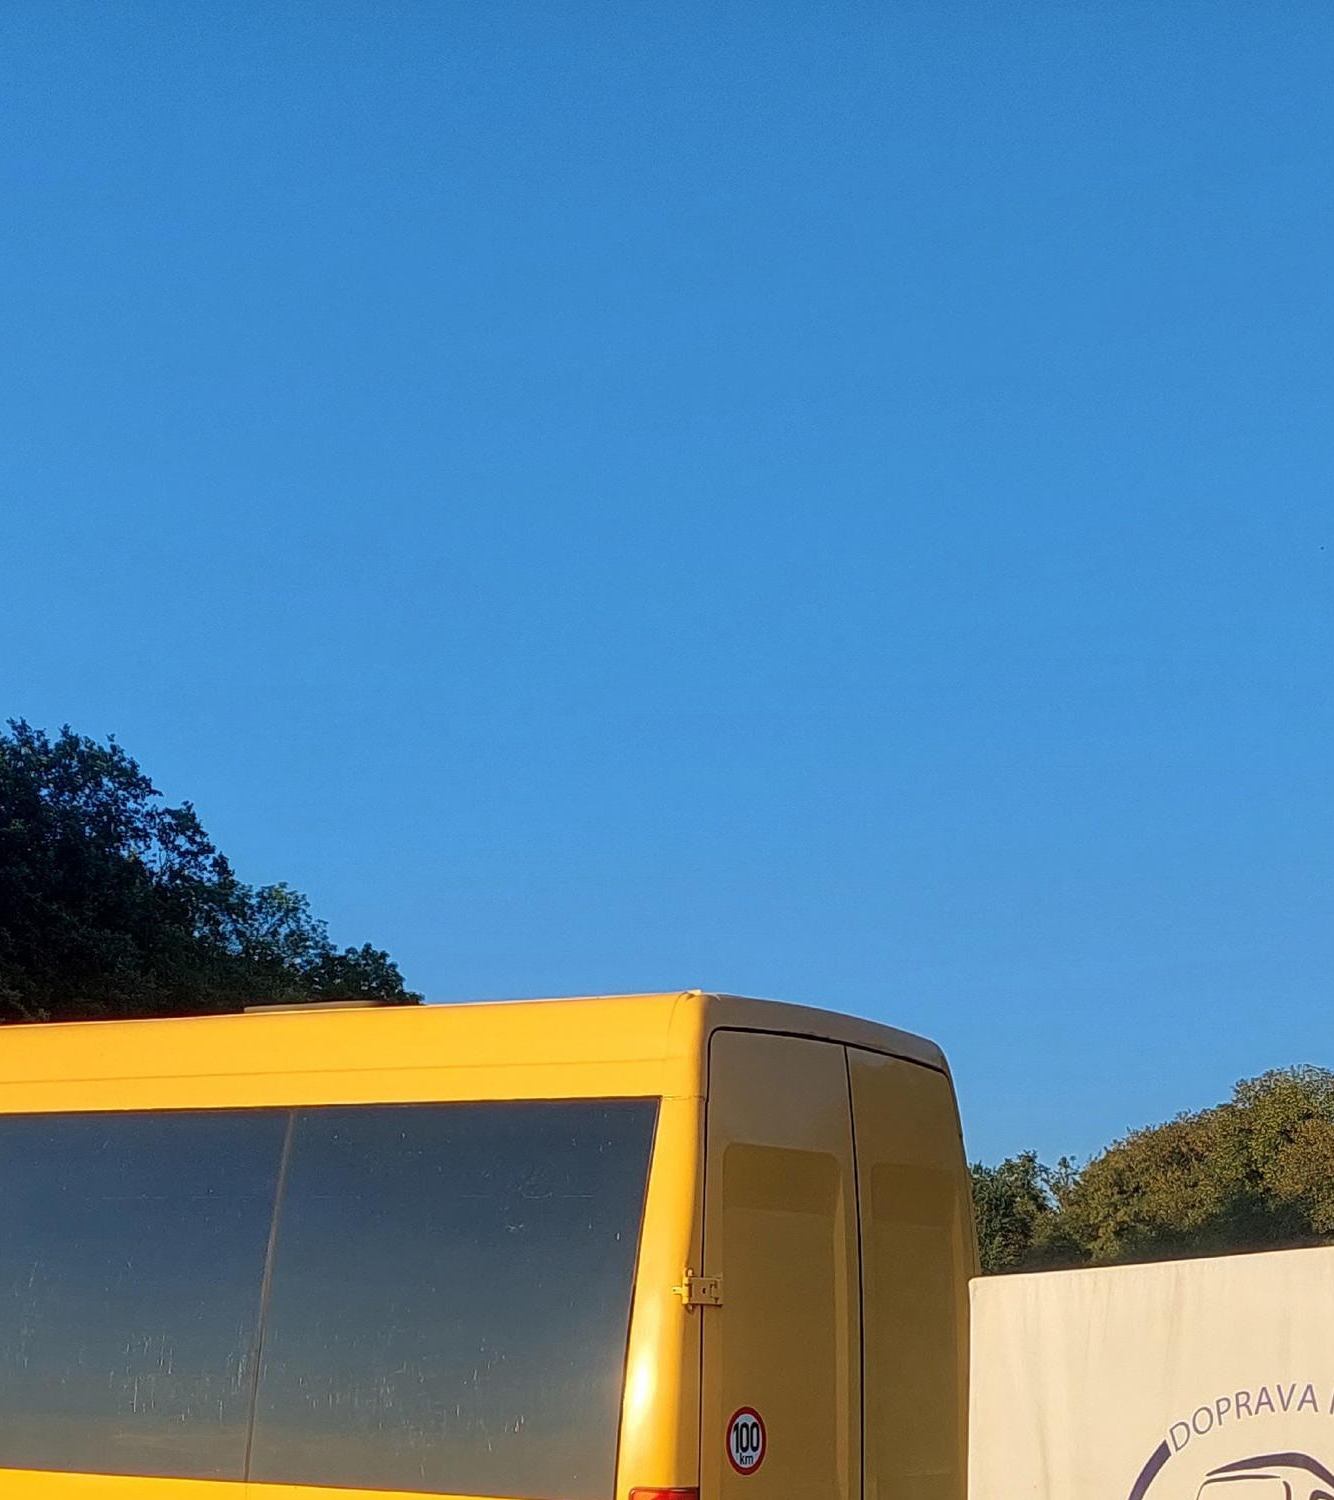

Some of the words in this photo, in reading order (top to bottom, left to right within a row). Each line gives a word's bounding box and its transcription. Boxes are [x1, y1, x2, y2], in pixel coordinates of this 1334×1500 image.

[1169, 1383, 1319, 1452] DOPRAVA
[732, 1421, 760, 1453] 100
[739, 1453, 754, 1465] km
